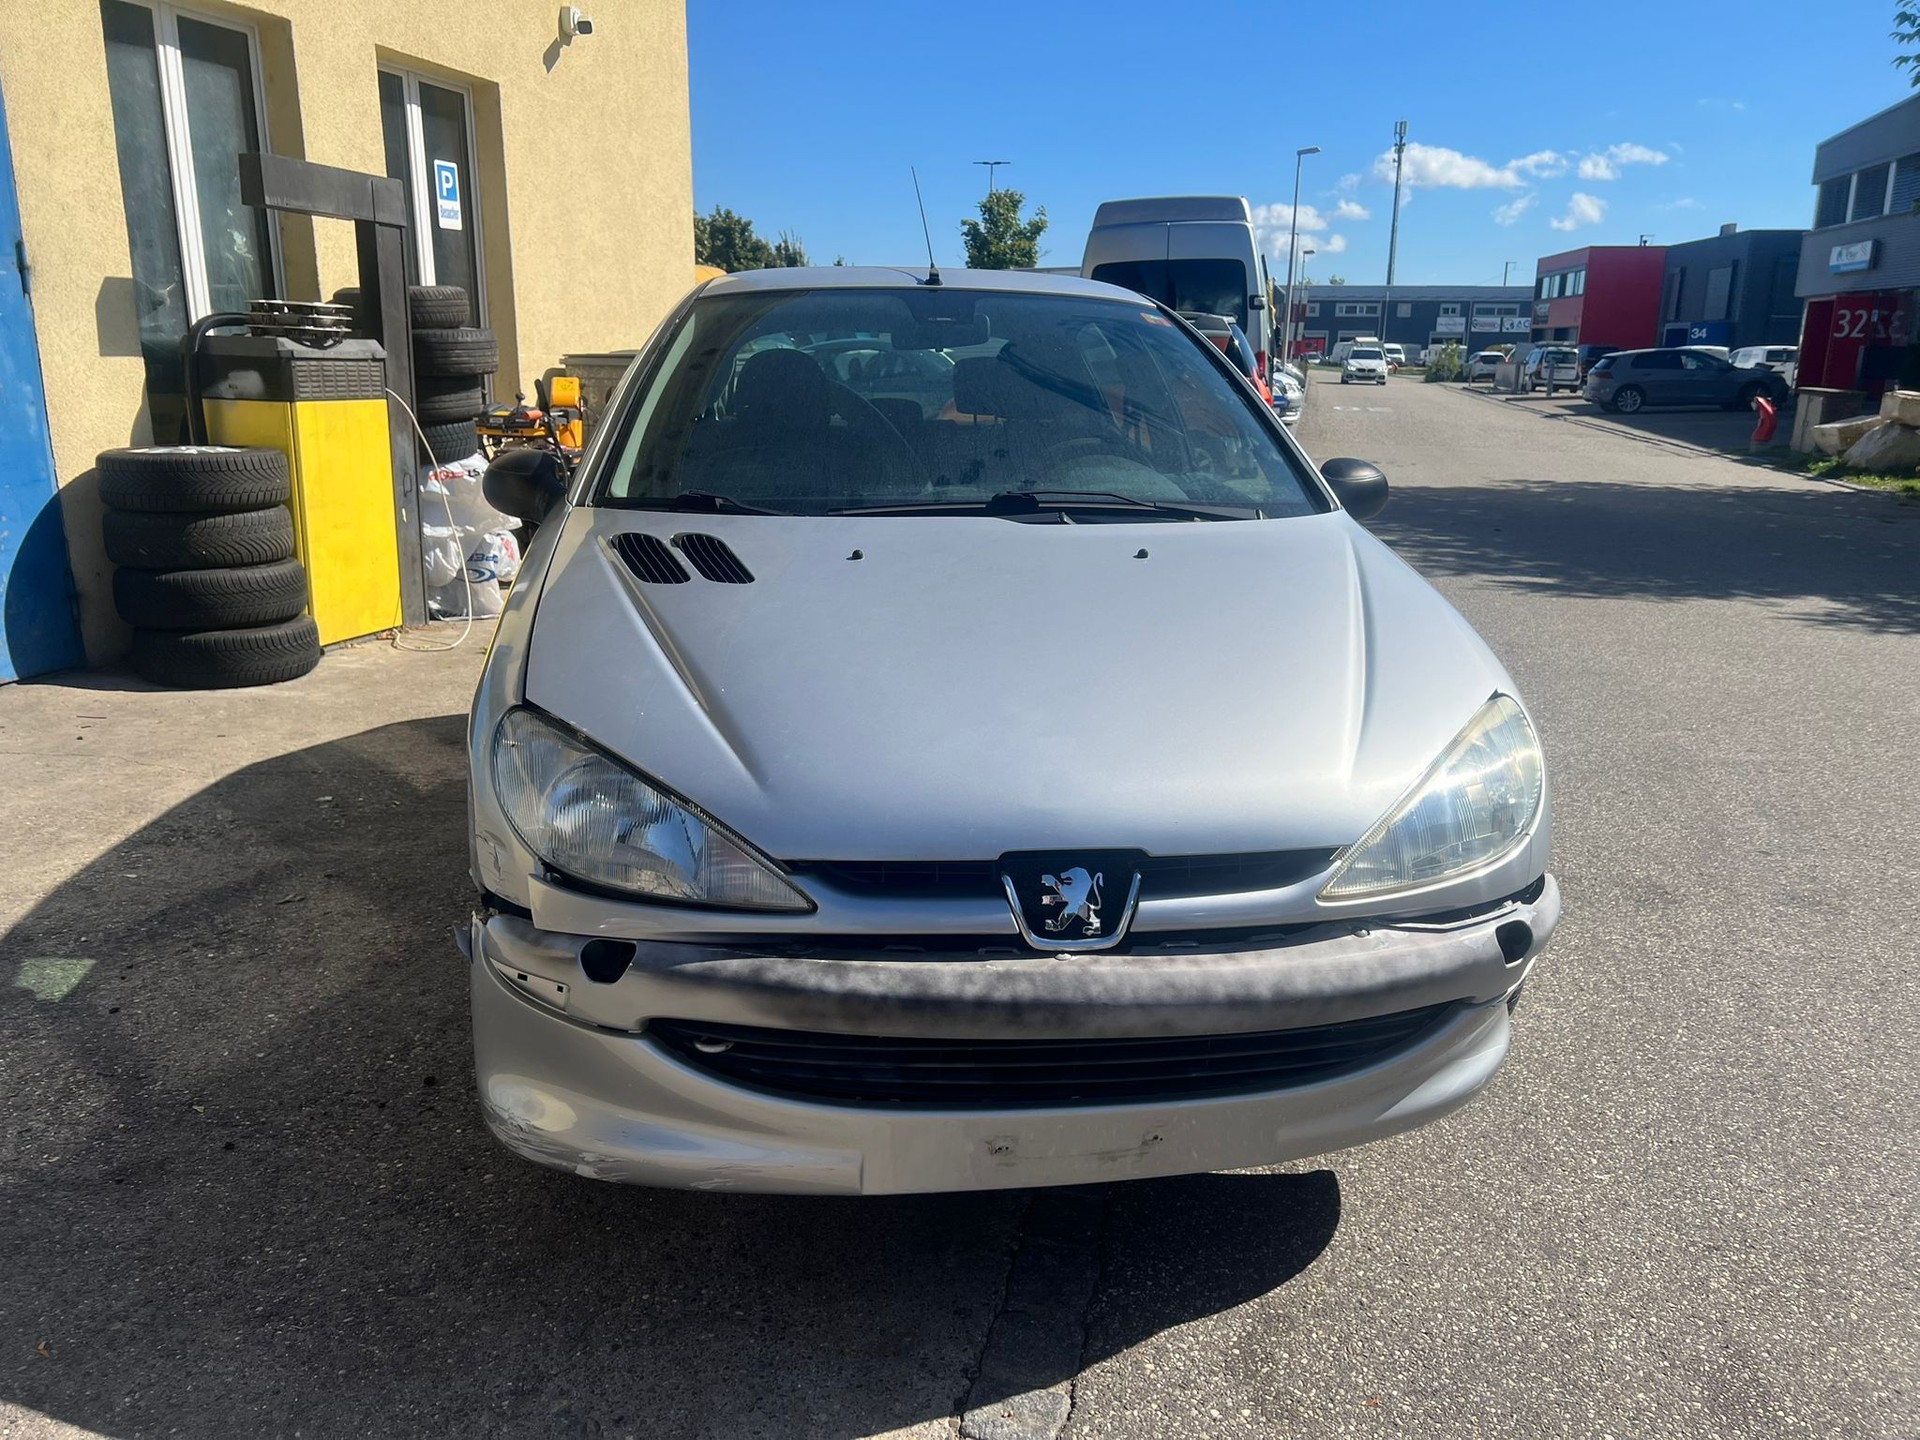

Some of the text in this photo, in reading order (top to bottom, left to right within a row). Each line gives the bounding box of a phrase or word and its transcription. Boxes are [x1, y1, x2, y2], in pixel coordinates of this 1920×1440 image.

[441, 170, 453, 197] P
[1691, 327, 1707, 339] 34
[1833, 309, 1868, 338] 32
